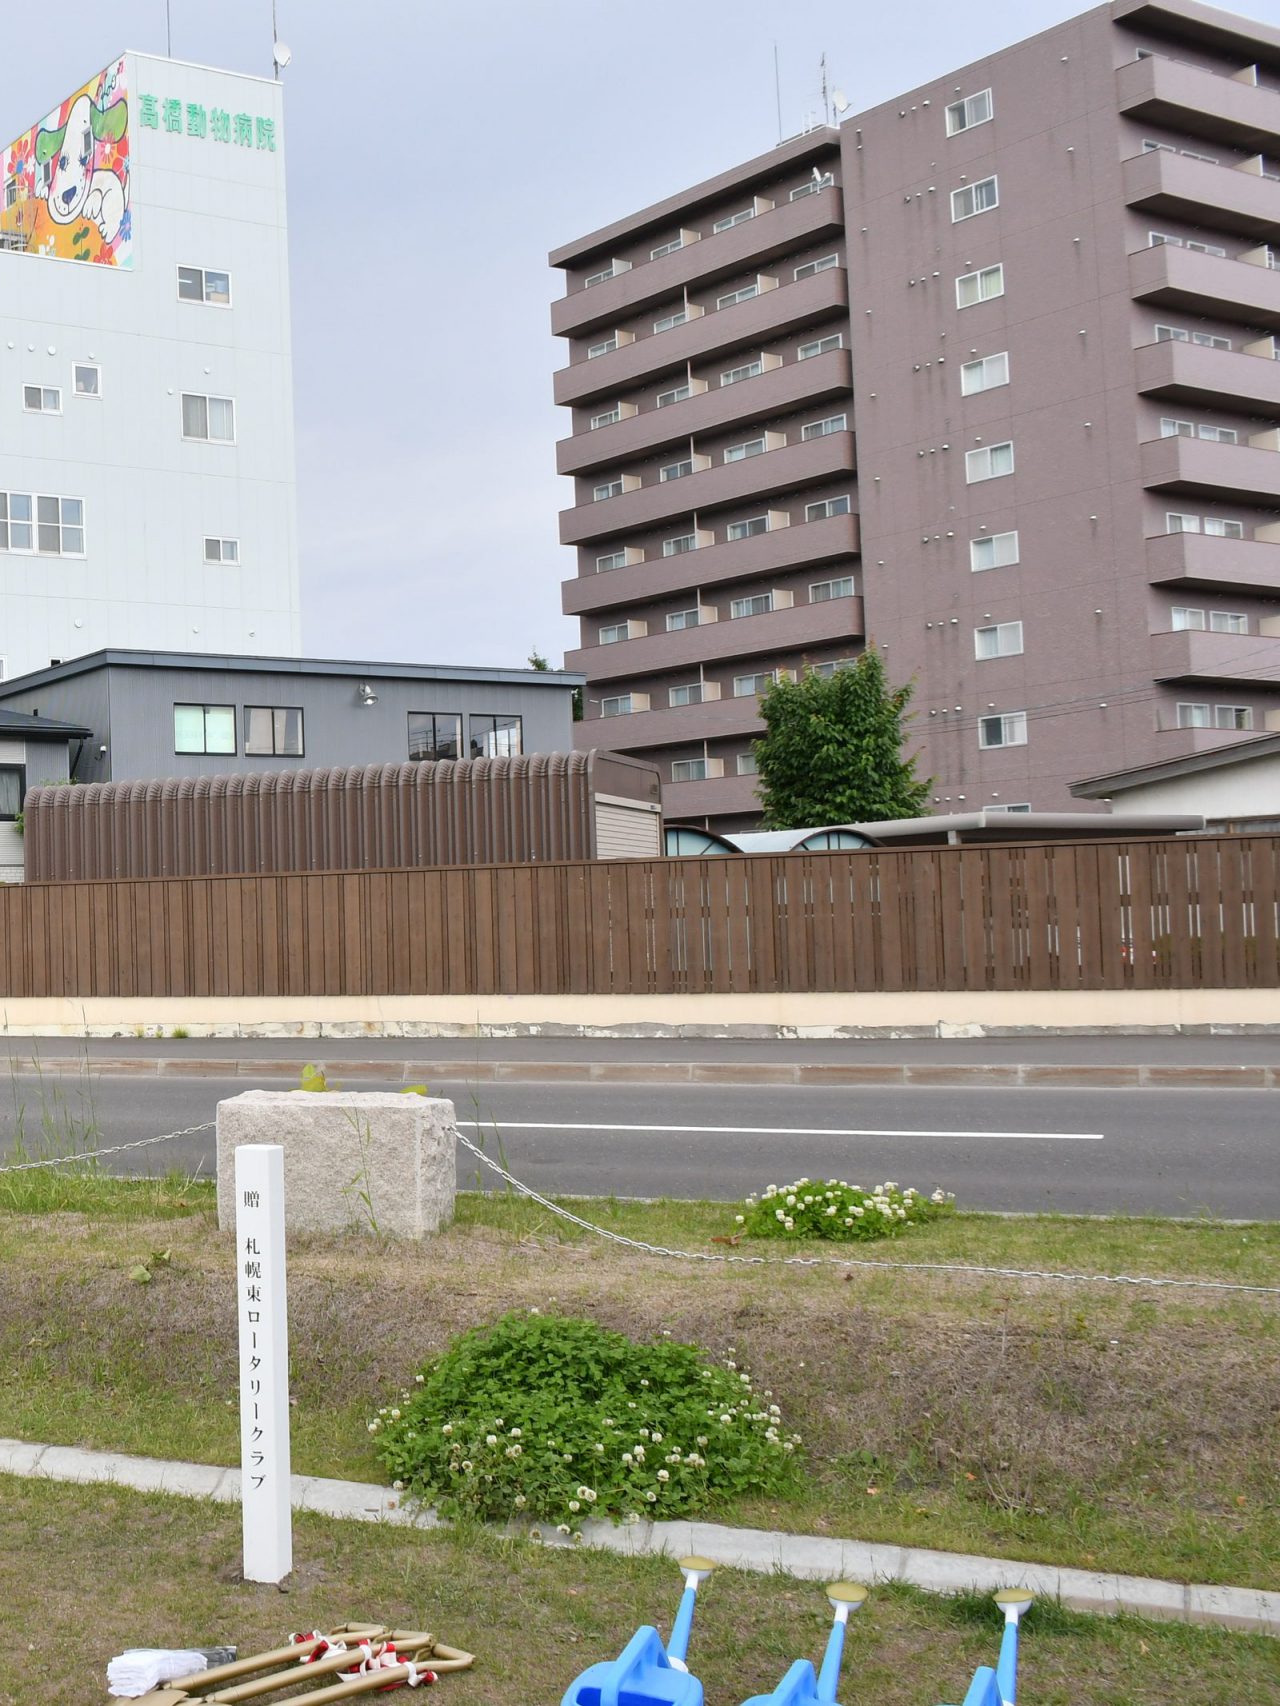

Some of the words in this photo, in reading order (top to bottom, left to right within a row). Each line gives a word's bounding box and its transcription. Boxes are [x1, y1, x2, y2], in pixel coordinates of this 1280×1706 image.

[243, 1190, 260, 1208] 贈
[244, 1237, 267, 1490] 札幌東ロータリークラブ
